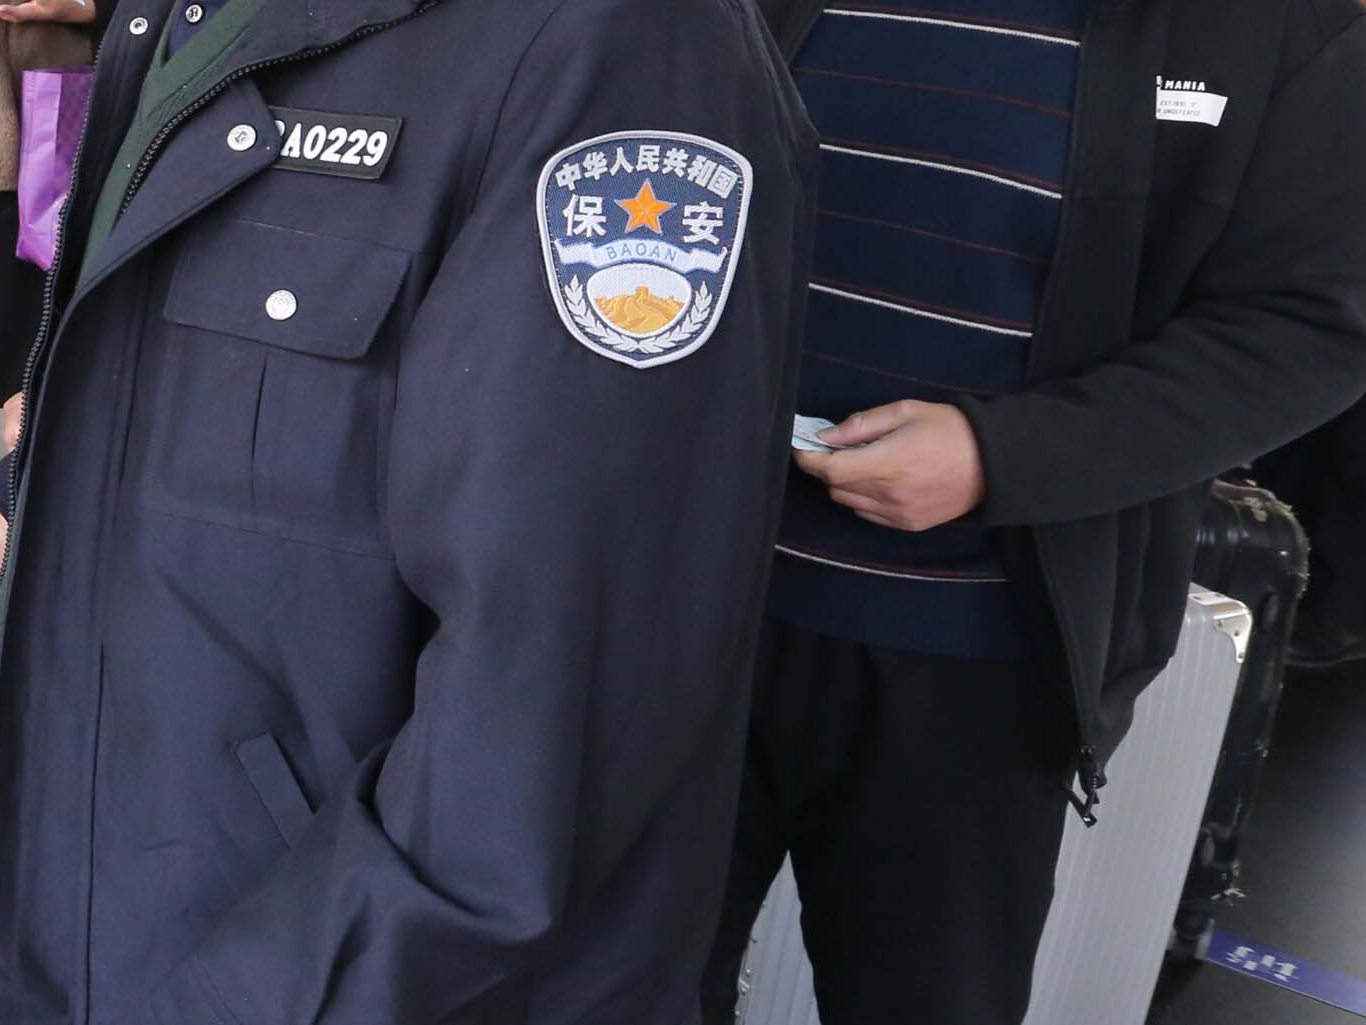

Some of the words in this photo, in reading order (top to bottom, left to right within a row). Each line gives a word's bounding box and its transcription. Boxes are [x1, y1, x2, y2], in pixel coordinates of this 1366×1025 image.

[555, 144, 739, 199] 中华人民共和国
[605, 242, 678, 263] BAOAN
